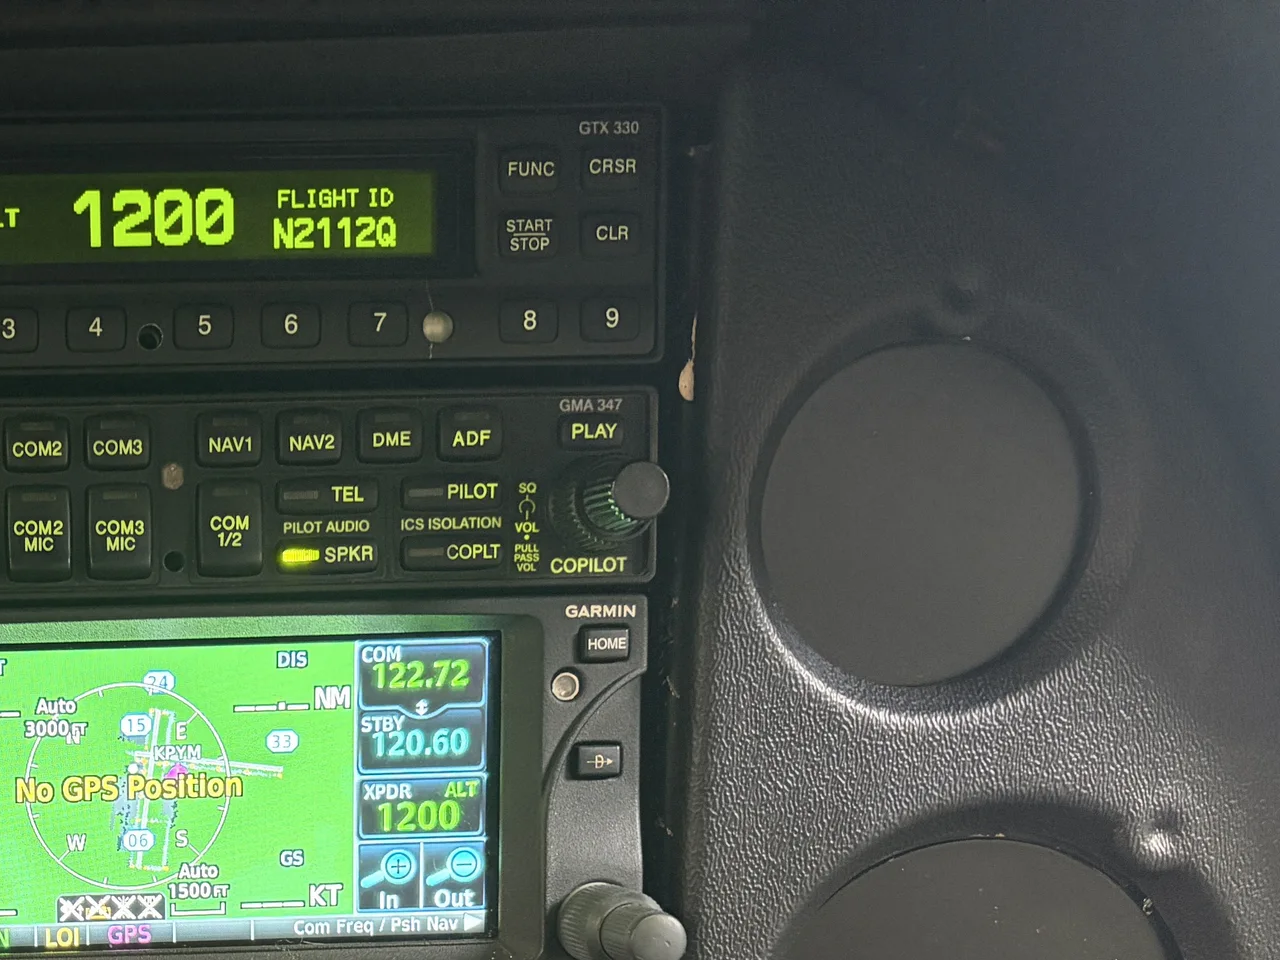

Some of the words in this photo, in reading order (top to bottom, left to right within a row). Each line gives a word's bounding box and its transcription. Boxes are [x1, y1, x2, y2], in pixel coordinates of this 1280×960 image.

[579, 122, 609, 135] GTX
[614, 122, 639, 134] 330
[508, 162, 554, 177] FUNC
[589, 159, 636, 174] CRSR
[277, 189, 358, 209] FLIGHT
[369, 188, 394, 207] ID
[74, 188, 234, 247] 1200
[506, 219, 552, 232] START
[273, 217, 396, 249] N2112Q
[596, 226, 628, 241] CLR
[510, 237, 549, 251] STOP
[560, 399, 593, 412] GMA
[598, 399, 622, 411] 347
[373, 431, 411, 447] DME
[453, 430, 491, 447] ADF
[572, 423, 617, 440] PLAY
[13, 441, 62, 456] COM2
[93, 440, 142, 455] COM3
[209, 437, 252, 453] NAV1
[289, 435, 334, 451] NAV2
[332, 487, 364, 501] TEL
[448, 484, 498, 499] PILOT
[14, 521, 63, 536] COM2
[210, 515, 249, 532] COM
[284, 521, 322, 533] PILOT
[325, 520, 370, 532] AUDIO
[401, 518, 424, 530] ICS
[428, 517, 501, 530] ISOLATION
[325, 546, 372, 562] SPKR
[448, 544, 500, 560] COPLT
[550, 557, 626, 573] COPILOT
[565, 605, 636, 618] GARMIN
[588, 638, 626, 650] HOME
[277, 651, 308, 668] DIS
[362, 647, 400, 663] COM
[372, 660, 469, 689] 122.72
[360, 717, 405, 732] STBY
[372, 728, 469, 757] 120.60
[15, 778, 53, 803] No
[62, 777, 118, 801] GPS
[127, 773, 242, 800] Position
[364, 783, 411, 800] XPDR
[444, 781, 479, 797] ALT
[378, 801, 460, 831] 1200
[435, 890, 473, 907] Out
[294, 918, 330, 935] Com
[337, 918, 375, 937] Freq
